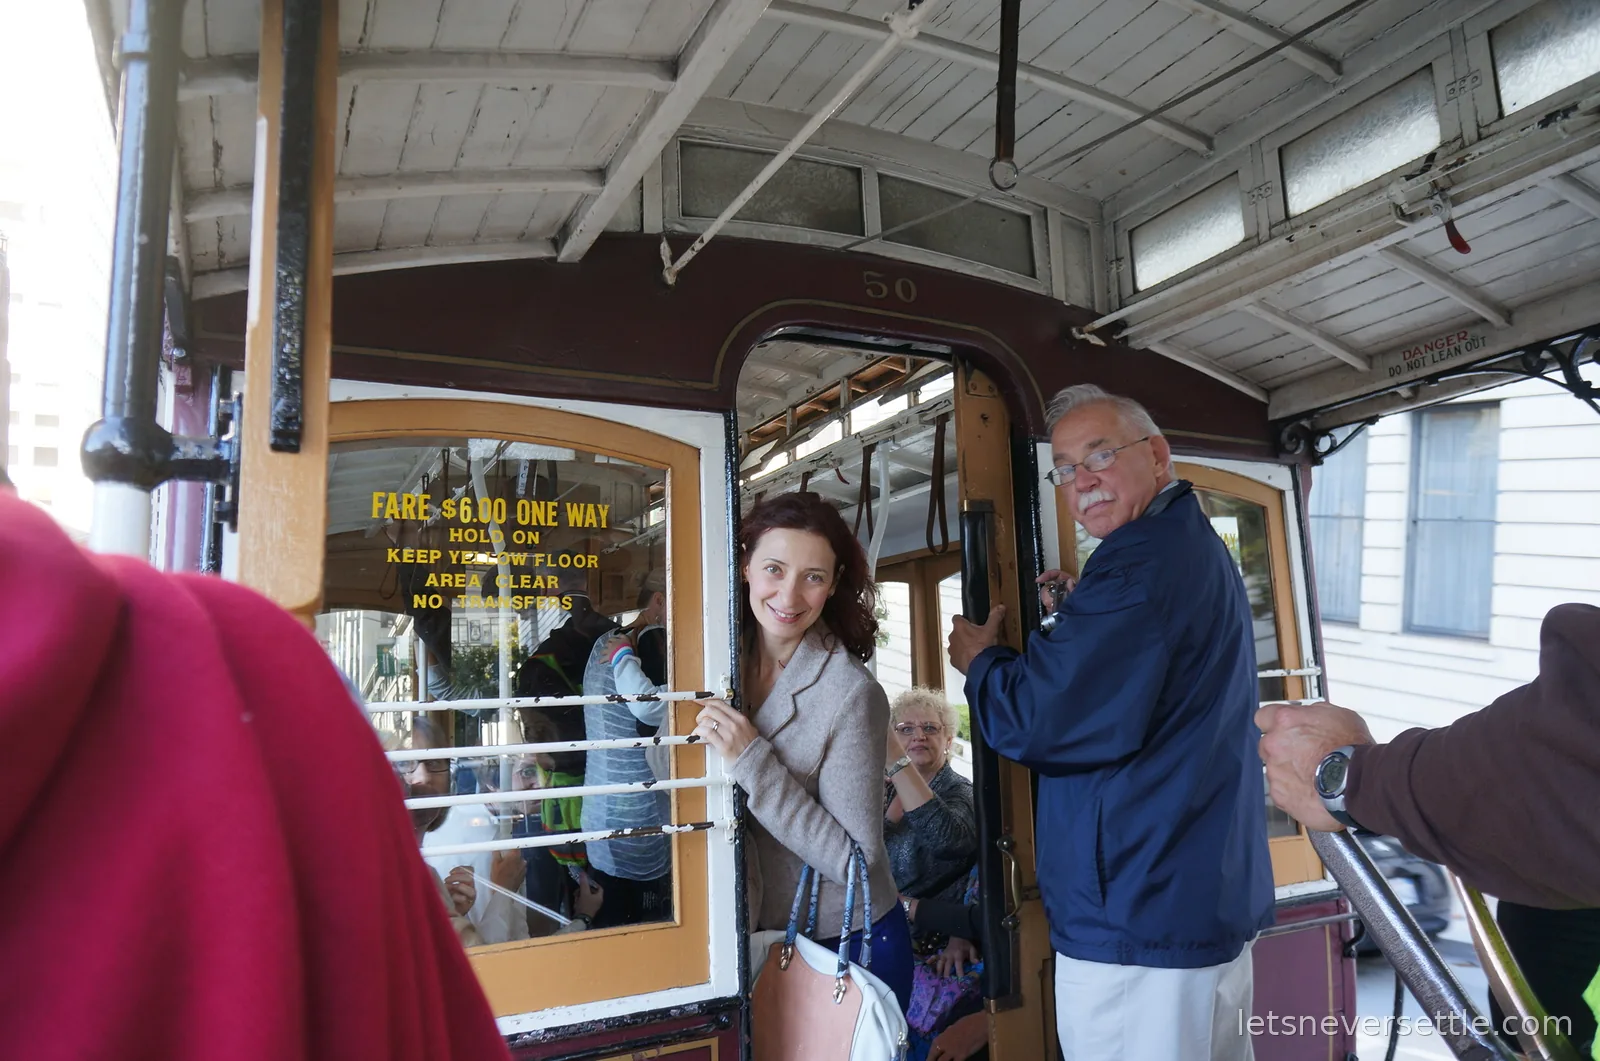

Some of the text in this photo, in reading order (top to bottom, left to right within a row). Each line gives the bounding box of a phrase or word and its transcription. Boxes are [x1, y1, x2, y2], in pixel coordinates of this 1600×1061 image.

[863, 270, 917, 303] 50
[1388, 335, 1487, 377] DO NOT LEAN OUT
[1402, 330, 1468, 361] DANGER
[371, 491, 610, 529] FARE $6.00 ONE WAY
[449, 527, 540, 545] HOLD ON
[386, 548, 599, 569] KEEP YELLOW FLOOR
[424, 573, 559, 589] AREA CLEAR
[413, 594, 573, 611] NO TRANSFERS
